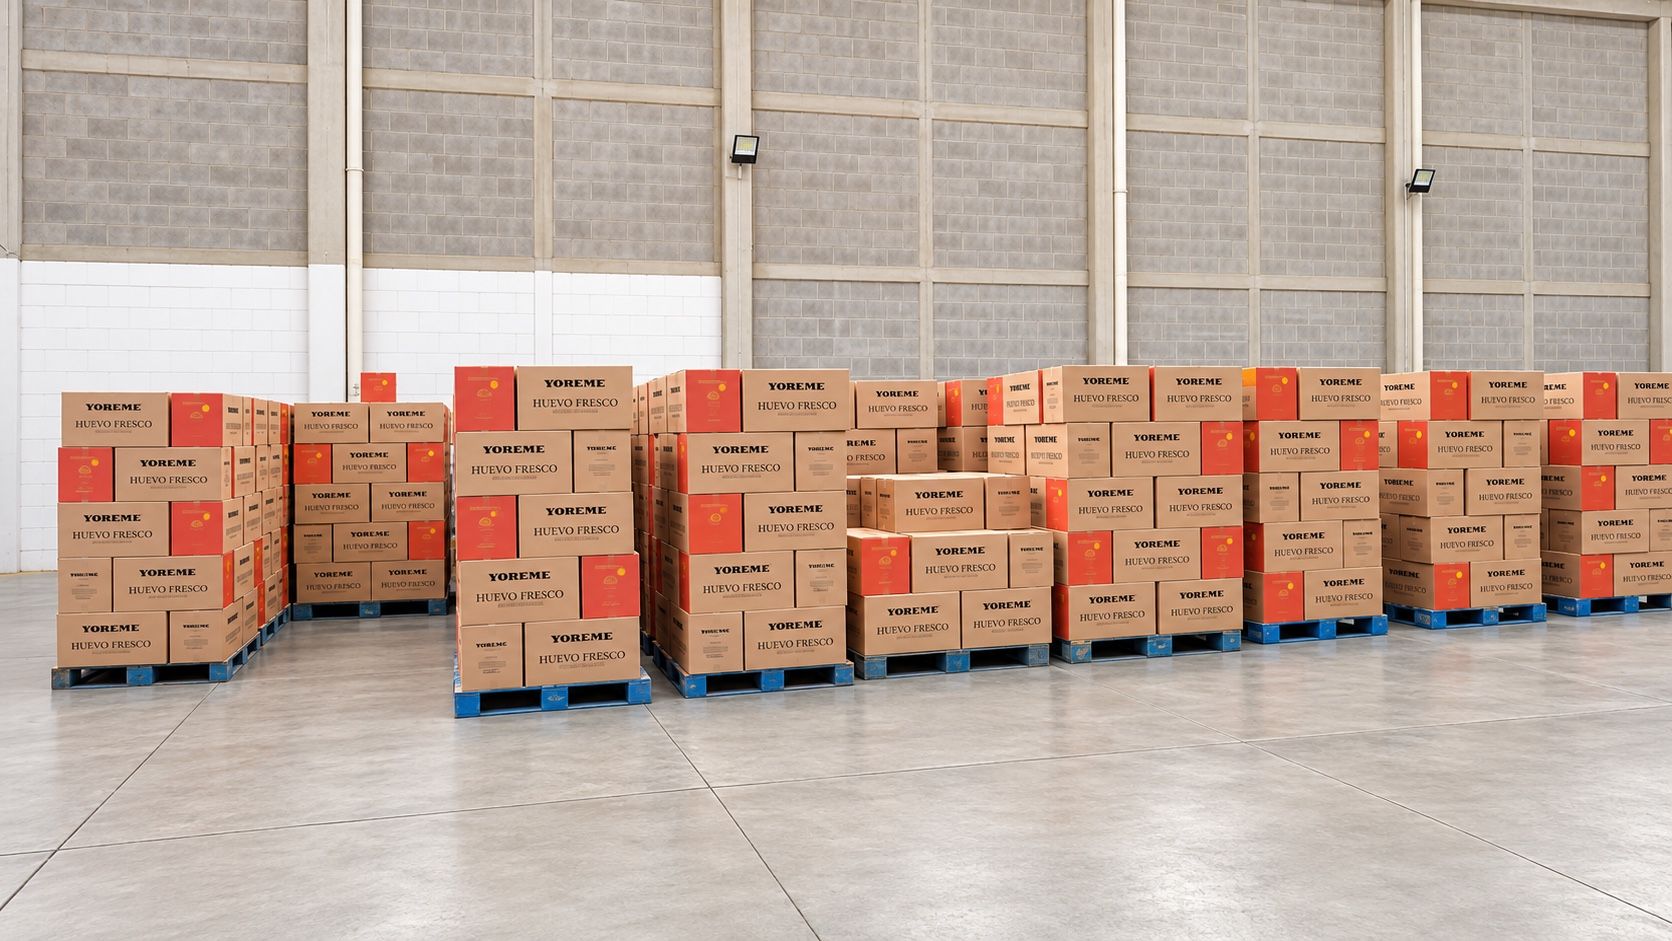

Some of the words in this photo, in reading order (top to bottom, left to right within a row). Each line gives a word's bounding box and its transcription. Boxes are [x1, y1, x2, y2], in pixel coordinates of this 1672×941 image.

[544, 379, 605, 388] YOREME
[1082, 377, 1129, 385] YOREME
[768, 382, 825, 390] YOREME
[1107, 394, 1139, 402] FRESCO
[1200, 394, 1232, 402] FRESCO
[86, 403, 141, 411] YOREME
[533, 399, 572, 408] HUEVO
[575, 399, 618, 407] FRESCO
[758, 402, 795, 410] HUEVO
[798, 401, 837, 410] FRESCO
[75, 420, 111, 428] HUEVO
[114, 420, 152, 428] FRESCO
[483, 445, 545, 454] YOREME
[712, 446, 769, 454] YOREME
[855, 453, 886, 461] FRESCO
[1125, 451, 1155, 459] HUEVO
[140, 459, 196, 467] YOREME
[471, 465, 512, 475] HUEVO
[515, 464, 558, 473] FRESCO
[701, 465, 739, 474] HUEVO
[741, 464, 781, 473] FRESCO
[130, 476, 167, 484] HUEVO
[169, 476, 208, 484] FRESCO
[915, 491, 964, 499] YOREME
[1087, 489, 1134, 497] YOREME
[1177, 487, 1224, 495] YOREME
[546, 506, 607, 515] YOREME
[768, 505, 823, 513] YOREME
[1078, 506, 1109, 514] HUEVO
[1111, 505, 1143, 513] FRESCO
[1169, 504, 1199, 512] HUEVO
[84, 514, 141, 522] YOREME
[758, 523, 794, 532] HUEVO
[797, 522, 835, 531] FRESCO
[1597, 519, 1634, 527] YOREME
[72, 531, 110, 539] HUEVO
[113, 530, 153, 539] FRESCO
[534, 527, 574, 536] HUEVO
[577, 525, 619, 534] FRESCO
[1447, 526, 1487, 534] YOREME
[1282, 532, 1325, 540] YOREME
[1134, 540, 1181, 548] YOREME
[935, 547, 985, 555] YOREME
[1125, 558, 1155, 566] HUEVO
[1157, 556, 1190, 564] FRESCO
[714, 565, 770, 574] YOREME
[925, 565, 959, 574] HUEVO
[961, 563, 996, 572] FRESCO
[1487, 569, 1525, 577] YOREME
[488, 571, 551, 581] YOREME
[1323, 578, 1365, 587] YOREME
[128, 585, 166, 594] HUEVO
[169, 585, 208, 593] FRESCO
[703, 584, 740, 594] HUEVO
[743, 582, 782, 591] FRESCO
[476, 592, 517, 602] HUEVO
[520, 590, 564, 600] FRESCO
[1089, 594, 1136, 604] YOREME
[1179, 590, 1224, 599] YOREME
[983, 601, 1031, 610] YOREME
[887, 606, 939, 616] YOREME
[1171, 608, 1201, 617] HUEVO
[1202, 606, 1233, 614] FRESCO
[1080, 613, 1110, 622] HUEVO
[1112, 610, 1145, 619] FRESCO
[768, 620, 823, 630] YOREME
[973, 619, 1006, 629] HUEVO
[1007, 617, 1041, 626] FRESCO
[82, 624, 140, 633] YOREME
[877, 625, 911, 635] HUEVO
[913, 623, 949, 632] FRESCO
[551, 632, 613, 643] YOREME
[71, 641, 109, 650] HUEVO
[111, 640, 152, 649] FRESCO
[758, 640, 794, 650] HUEVO
[796, 638, 834, 647] FRESCO
[539, 653, 580, 664] HUEVO
[583, 651, 626, 661] FRESCO
